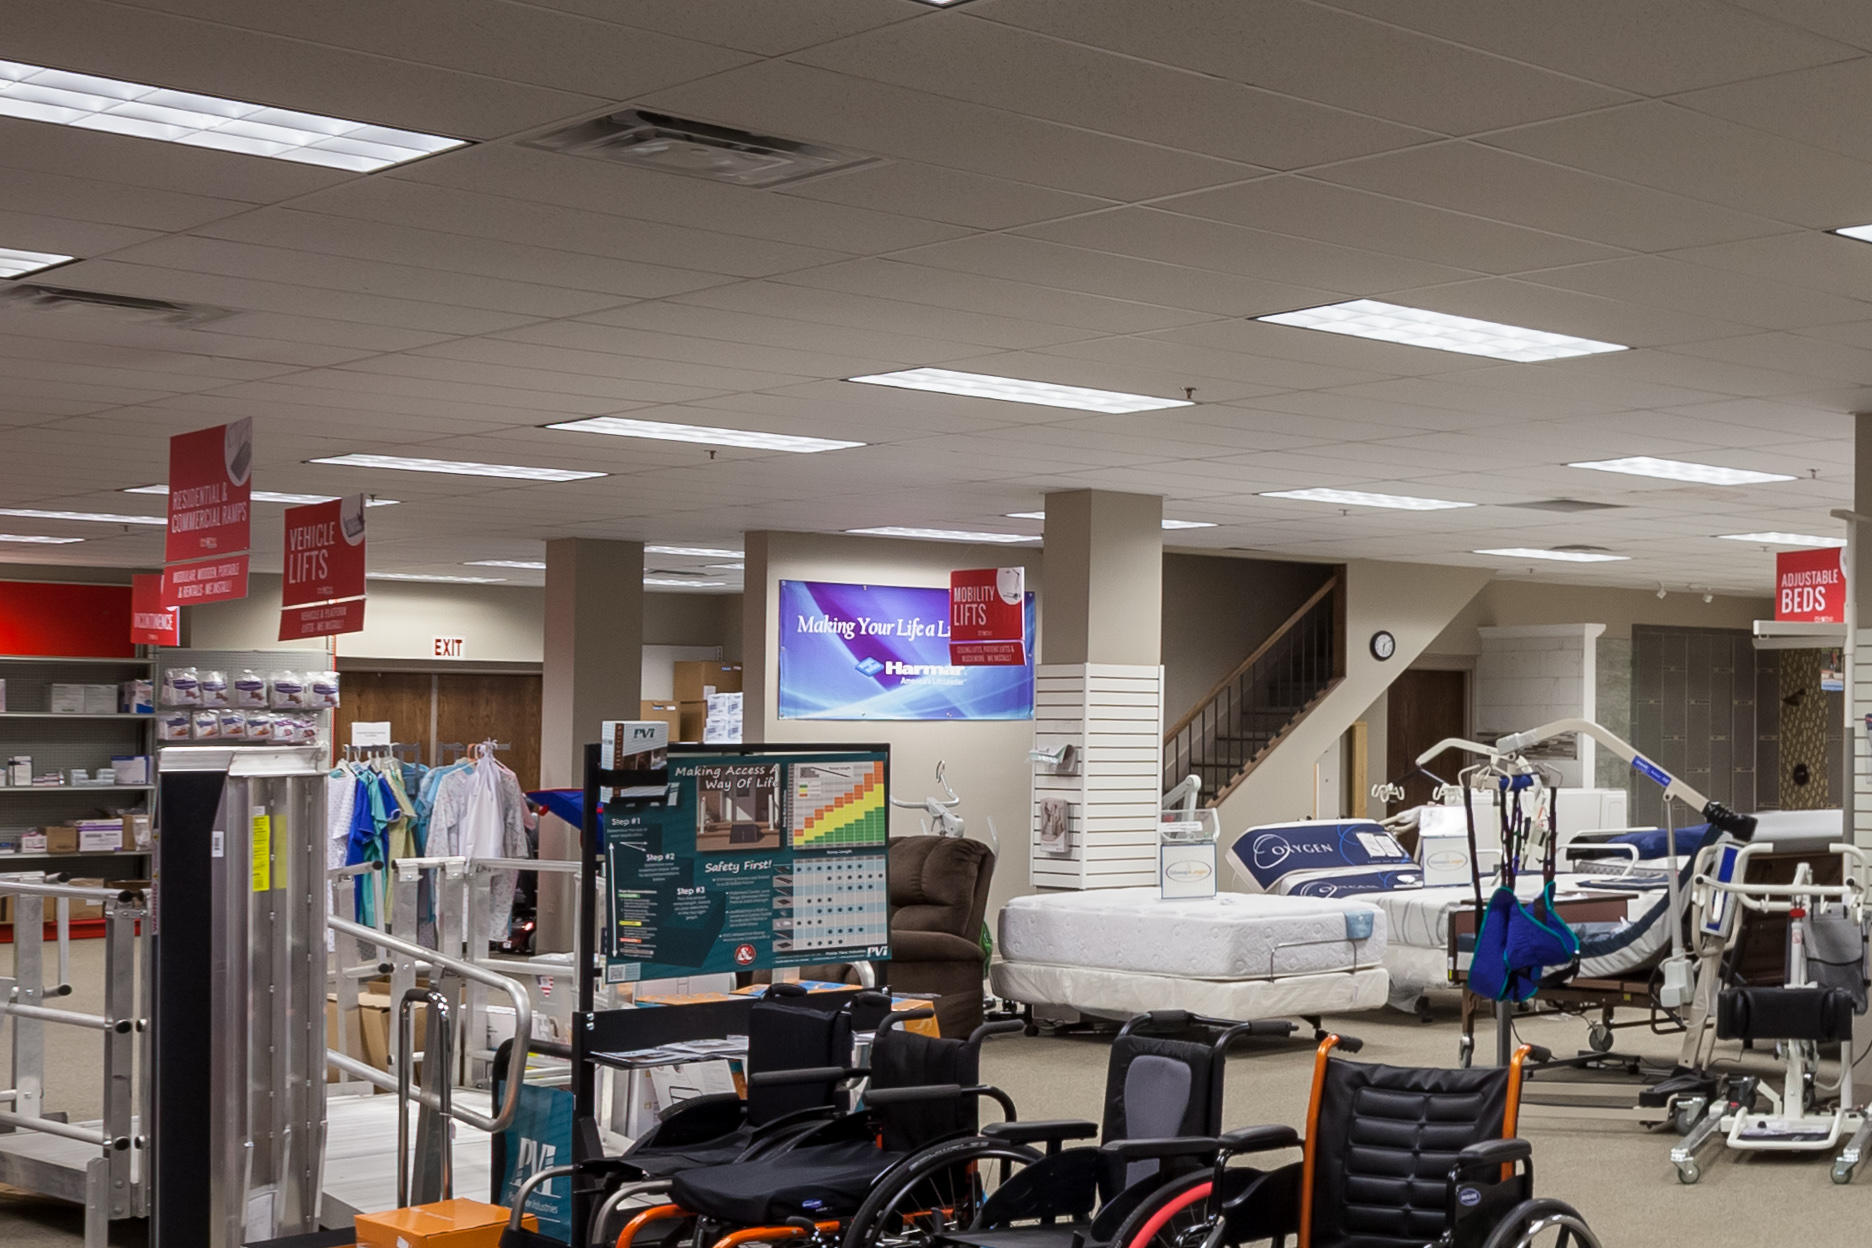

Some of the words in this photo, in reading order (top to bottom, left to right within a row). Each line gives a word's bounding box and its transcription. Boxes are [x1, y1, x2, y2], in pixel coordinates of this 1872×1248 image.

[172, 483, 219, 510] RESIDENTIAL
[171, 507, 220, 534] COMMERCIAL
[222, 501, 248, 524] RAMPS
[289, 521, 335, 551] VEHICLE
[289, 549, 328, 584] LIFTS
[1781, 569, 1838, 587] ADJUSTABLE
[953, 586, 995, 602] MOBILITY
[1781, 586, 1826, 614] BEDS
[953, 603, 986, 626] LIFTS
[797, 615, 855, 640] Making
[857, 617, 895, 636] Your
[897, 617, 923, 641] Life
[925, 625, 935, 637] a
[435, 639, 463, 656] EXIT
[885, 661, 965, 676] Harmar
[674, 764, 721, 778] Making
[725, 765, 765, 775] Access
[705, 779, 732, 791] Way
[736, 777, 752, 788] Of
[611, 818, 630, 827] Step
[631, 817, 641, 825] #1
[646, 853, 664, 862] Step
[665, 853, 675, 861] #2
[1271, 843, 1334, 856] OXYGEN
[704, 861, 740, 873] Safety
[744, 859, 772, 871] First!
[676, 887, 694, 896] Step
[696, 886, 705, 894] #3
